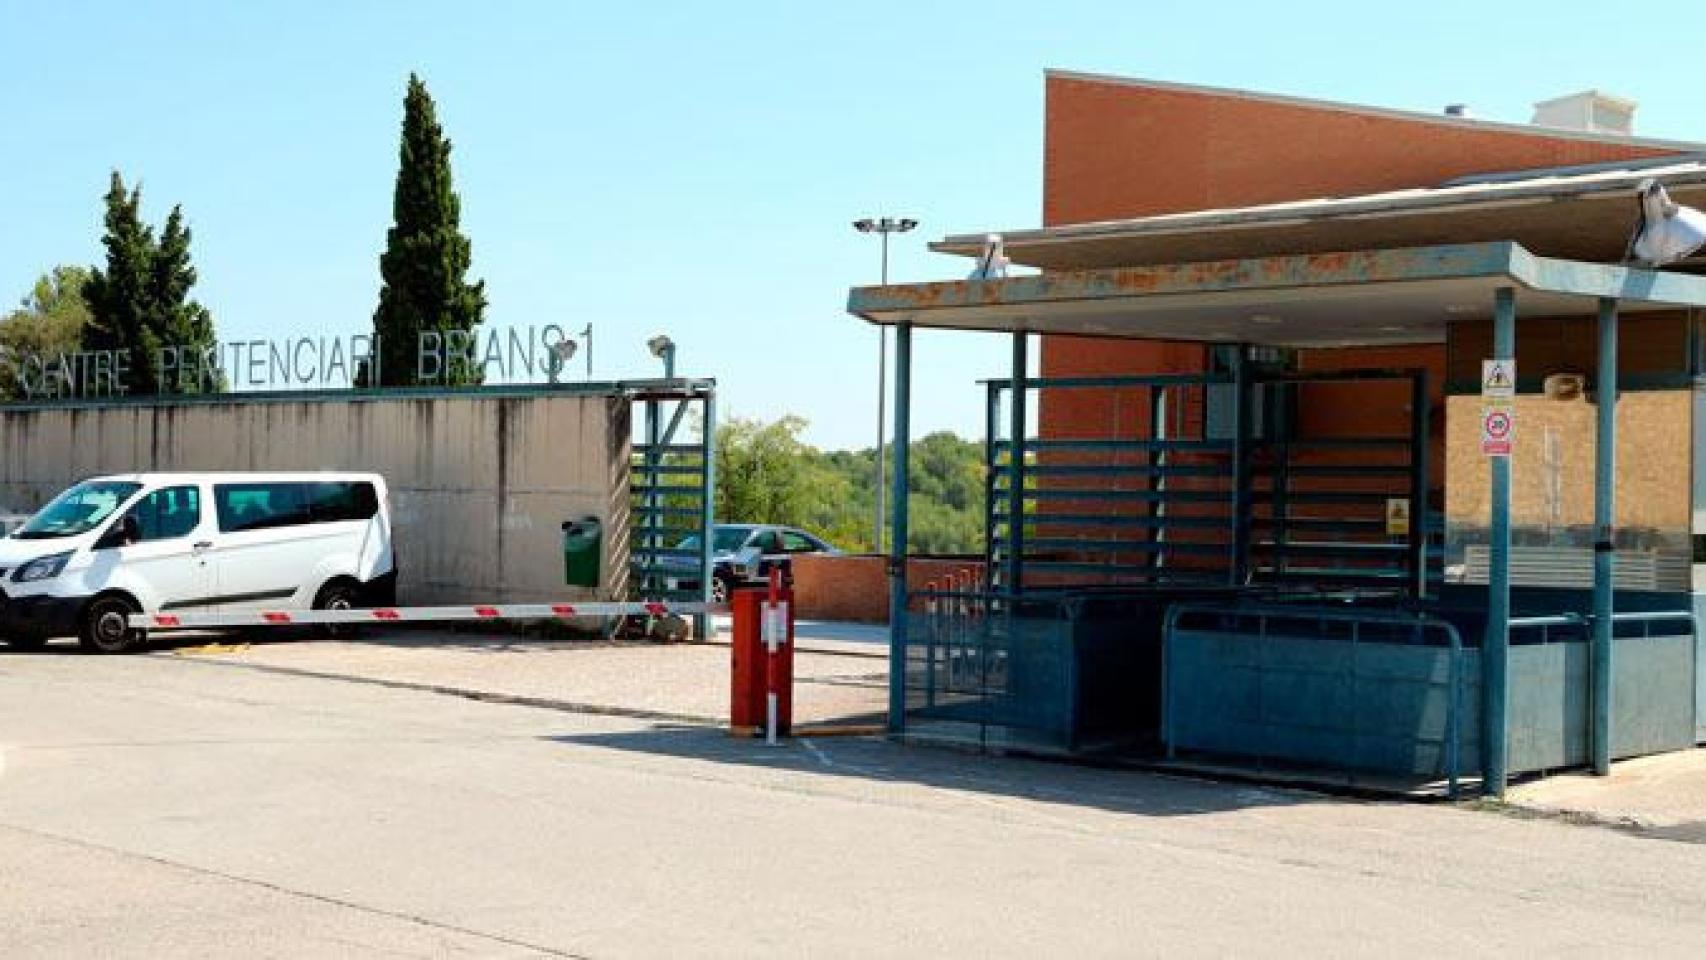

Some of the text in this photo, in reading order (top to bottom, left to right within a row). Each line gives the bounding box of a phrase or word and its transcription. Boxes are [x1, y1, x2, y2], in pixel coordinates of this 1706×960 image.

[22, 322, 593, 396] CENTRE PENITENCIARI BRIANS 1
